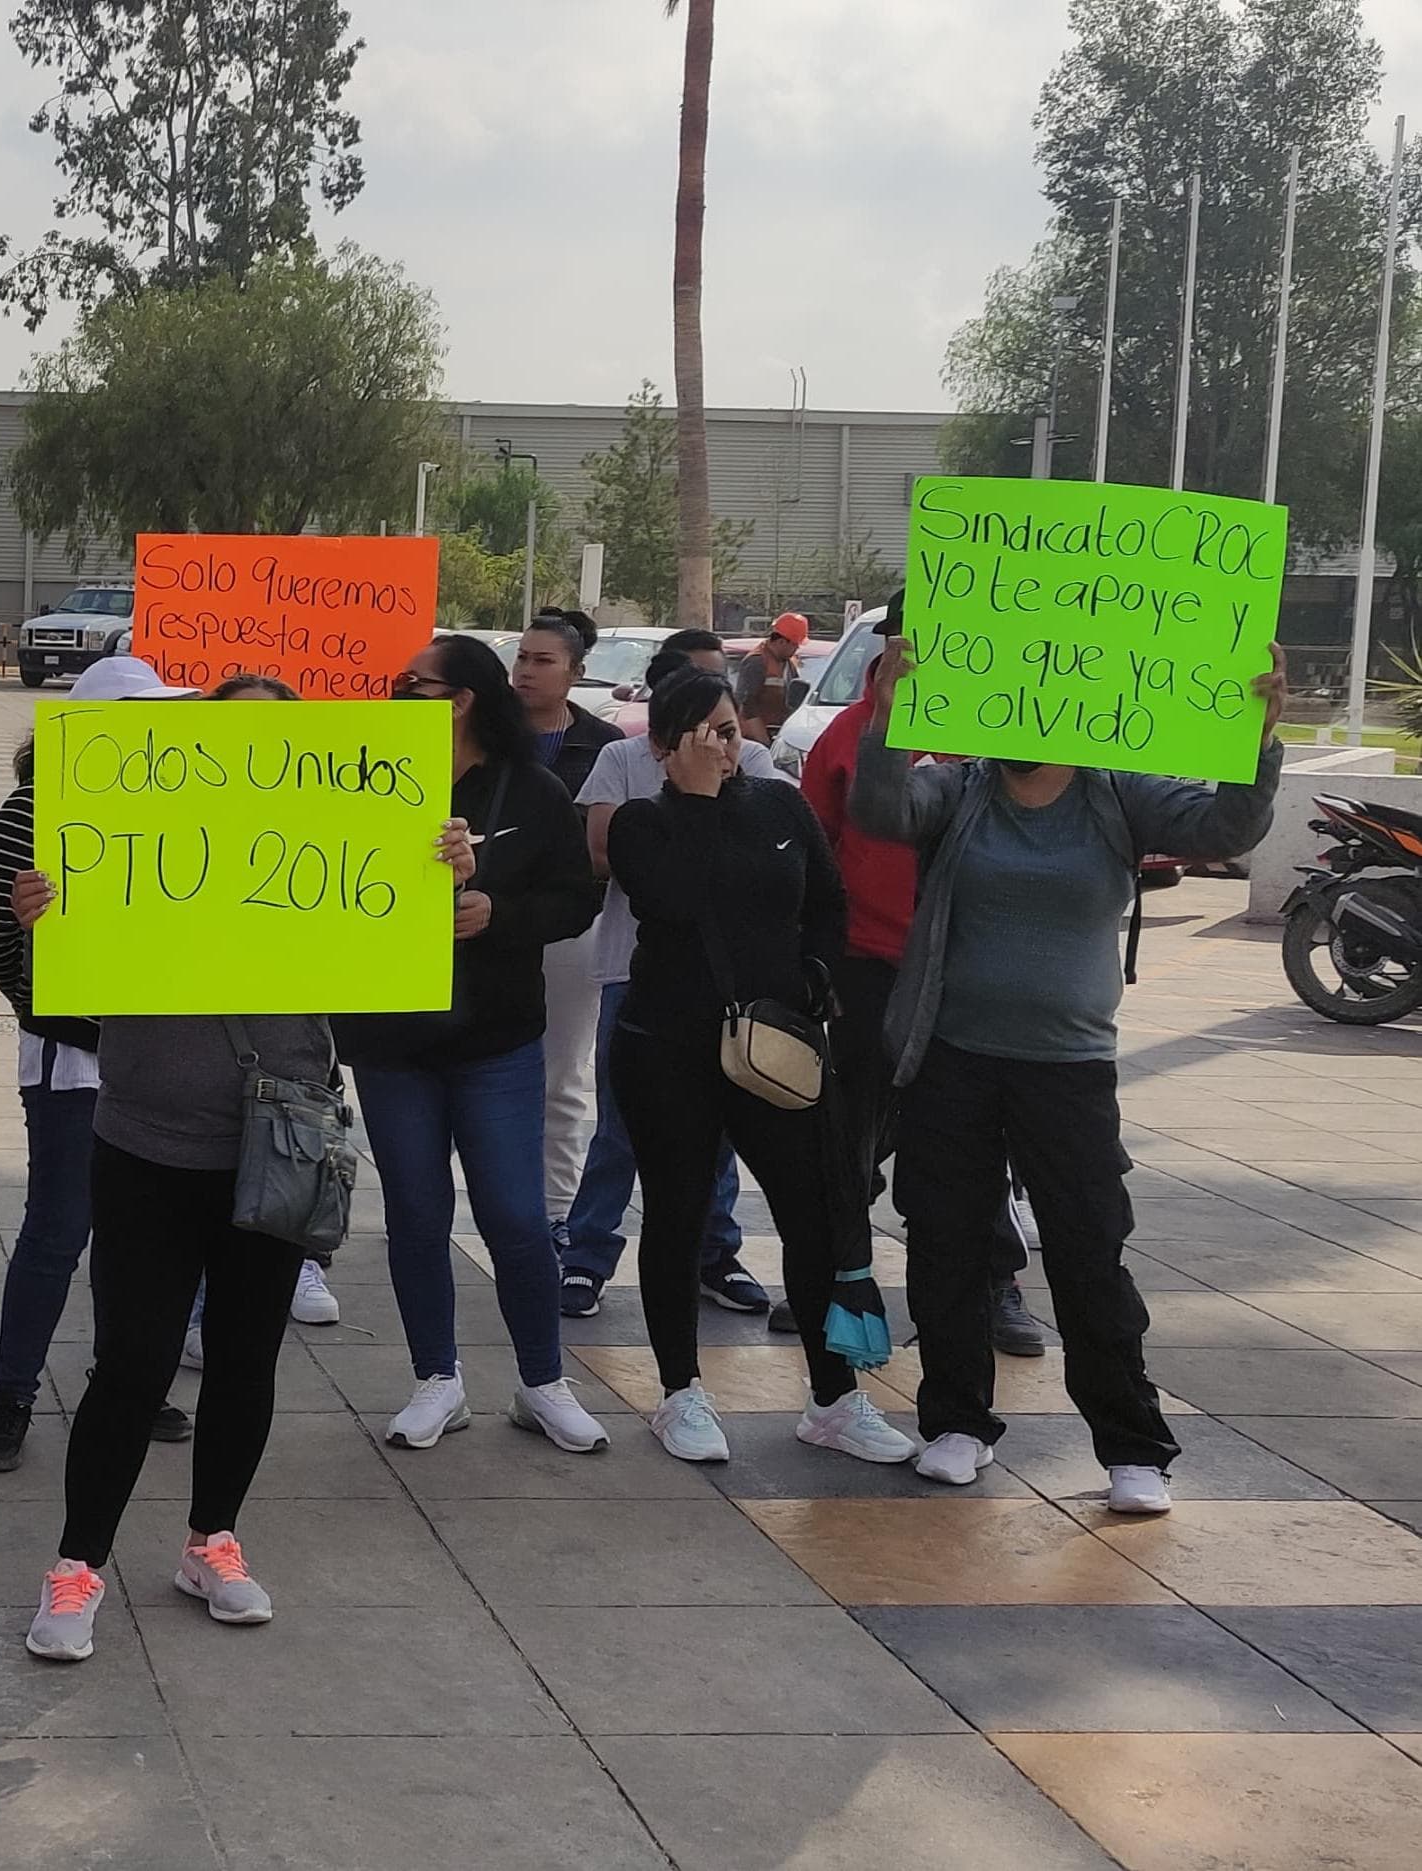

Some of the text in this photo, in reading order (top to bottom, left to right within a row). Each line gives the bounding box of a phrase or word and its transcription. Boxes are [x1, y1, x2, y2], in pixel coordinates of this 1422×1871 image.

[140, 544, 417, 616] Solo queremos
[990, 555, 1041, 612] te
[1055, 574, 1203, 636] apoye
[144, 601, 367, 665] respuesta de
[1022, 639, 1105, 688] que
[1129, 650, 1175, 702] ya
[900, 678, 1155, 751] te olvido
[56, 822, 396, 918] PTU 2016
